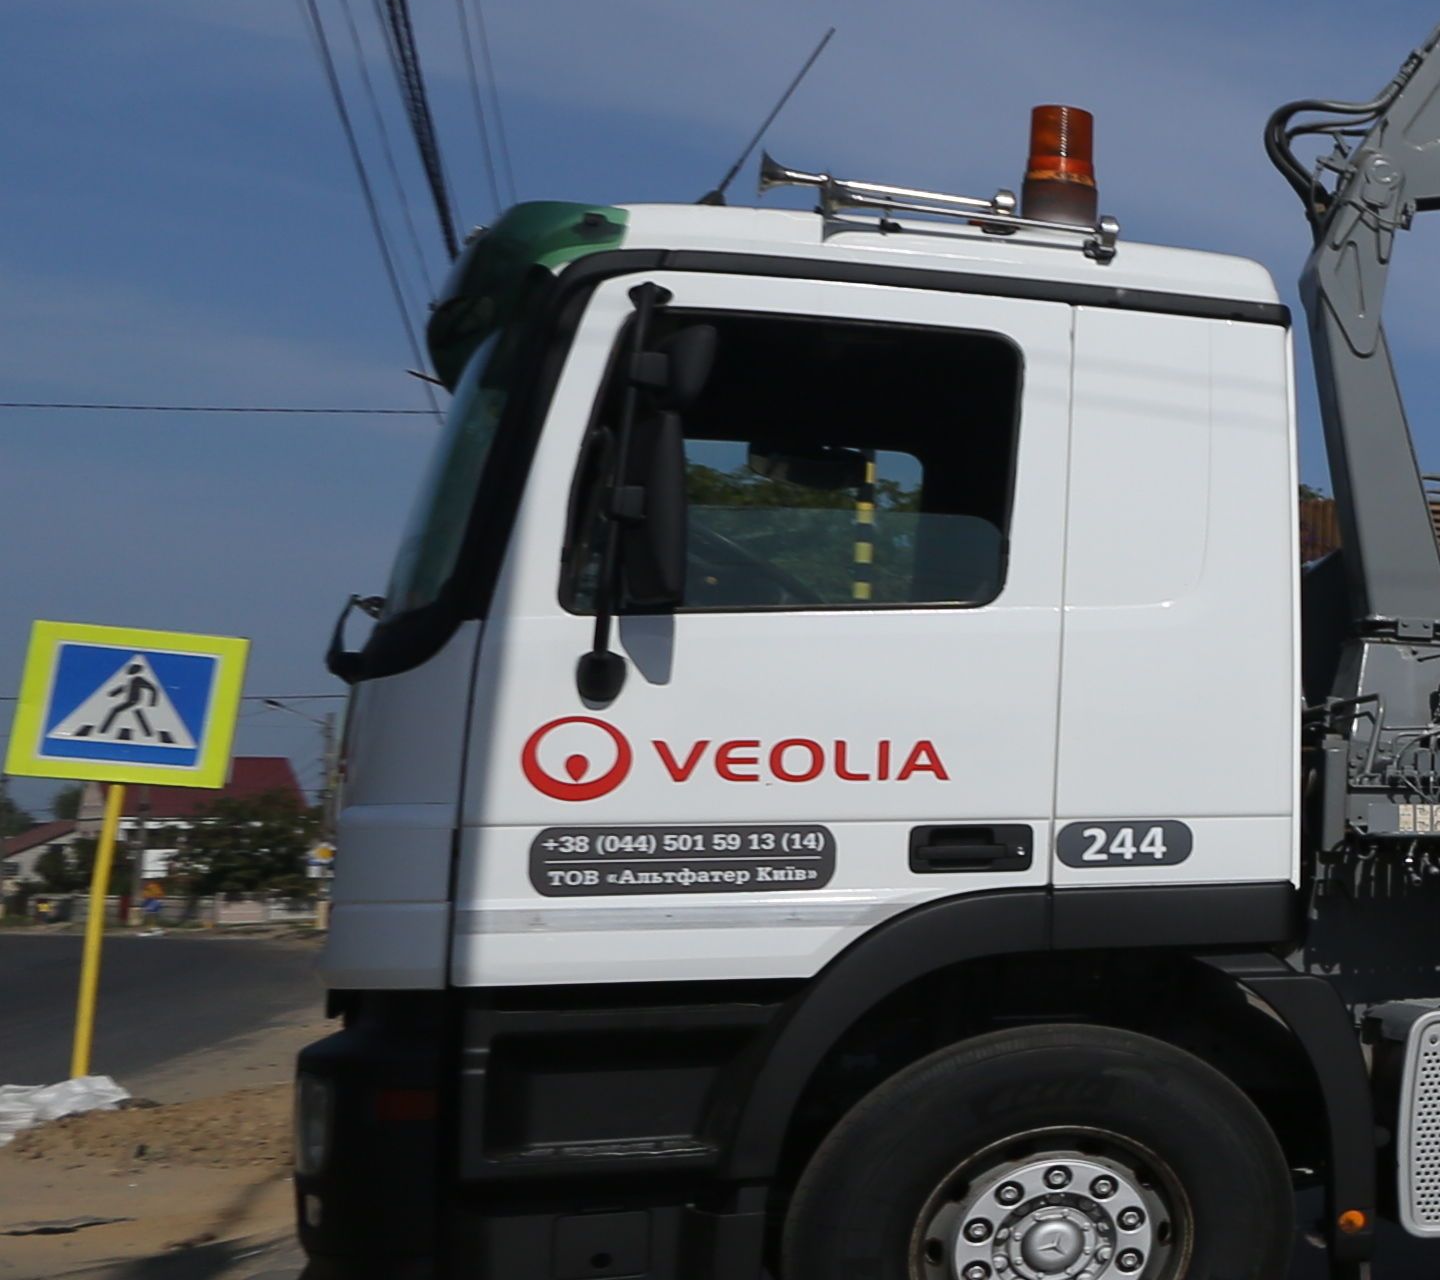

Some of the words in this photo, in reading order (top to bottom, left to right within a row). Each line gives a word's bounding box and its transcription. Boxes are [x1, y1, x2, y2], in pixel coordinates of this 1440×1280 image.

[651, 738, 950, 783] VEOLIA
[541, 835, 589, 854] +38
[599, 833, 657, 856] (044)
[663, 834, 705, 853] 501
[712, 833, 741, 852] 59
[748, 833, 776, 851] 13
[782, 831, 825, 852] (14)
[1082, 827, 1167, 861] 244
[548, 870, 599, 887] ТОВ
[606, 867, 750, 887] «Альтфатер
[756, 866, 817, 884] Київ»
